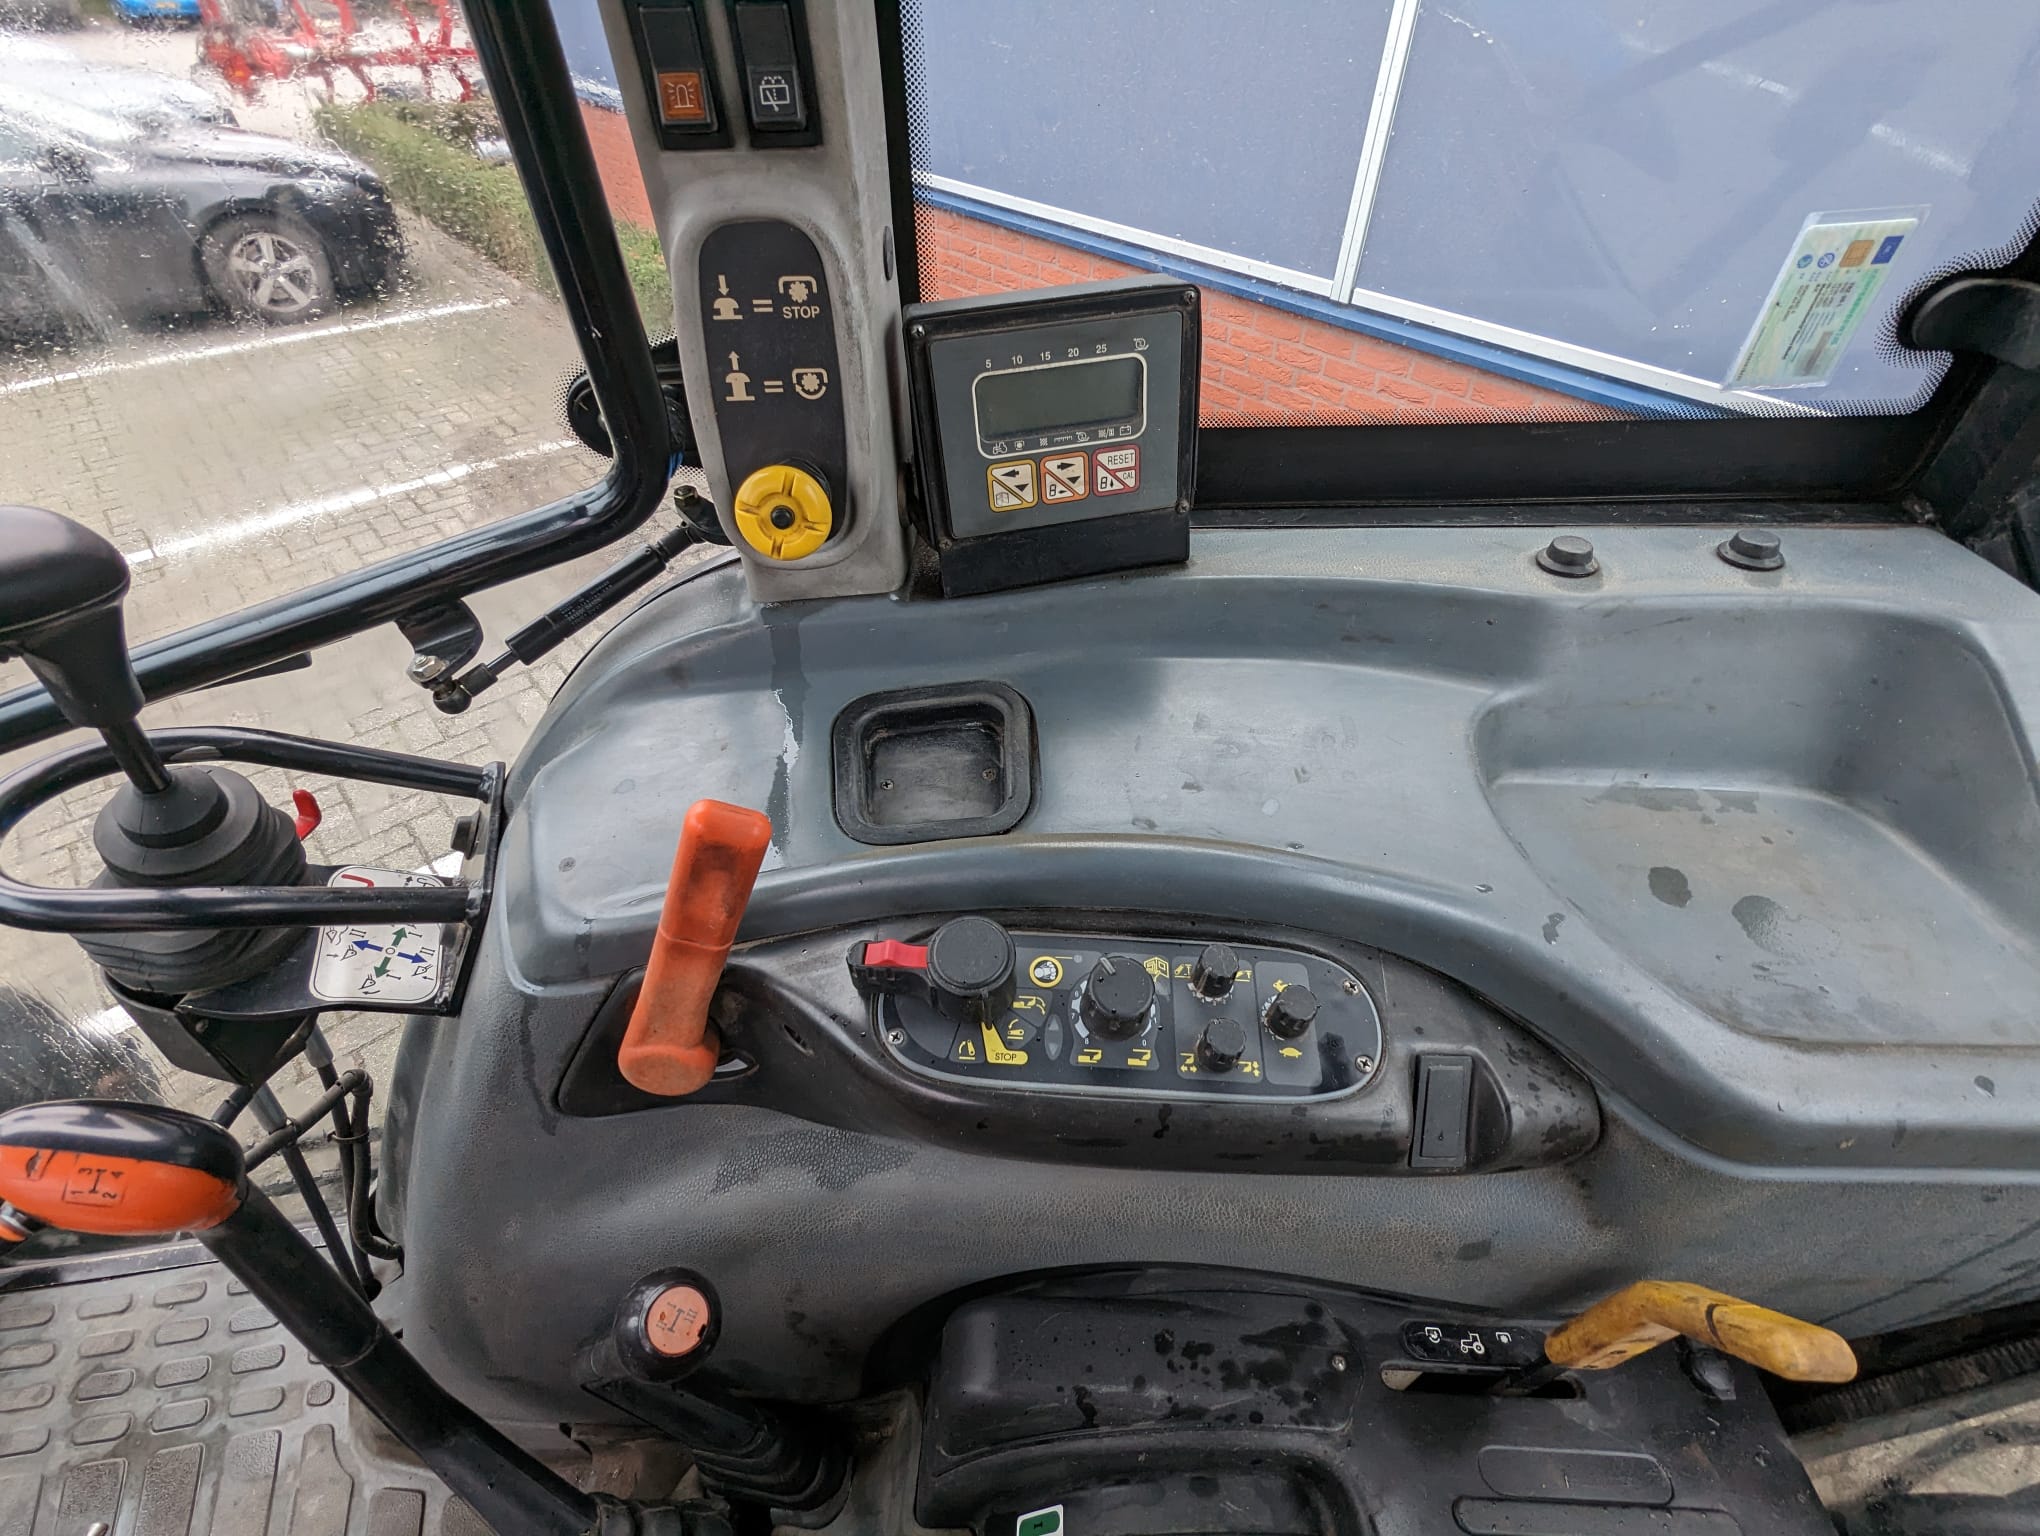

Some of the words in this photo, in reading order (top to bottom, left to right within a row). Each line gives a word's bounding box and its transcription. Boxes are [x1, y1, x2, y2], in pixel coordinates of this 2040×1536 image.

[782, 305, 820, 319] STOP
[985, 359, 992, 369] 5
[1011, 355, 1023, 365] 10
[1040, 351, 1051, 361] 15
[1067, 347, 1079, 358] 20
[1095, 343, 1107, 354] 25
[1107, 452, 1134, 466] RESET
[1122, 471, 1134, 480] CAL
[995, 1052, 1017, 1062] STOP
[78, 1167, 92, 1175] 3
[111, 1171, 124, 1179] 4
[102, 1191, 118, 1199] 2
